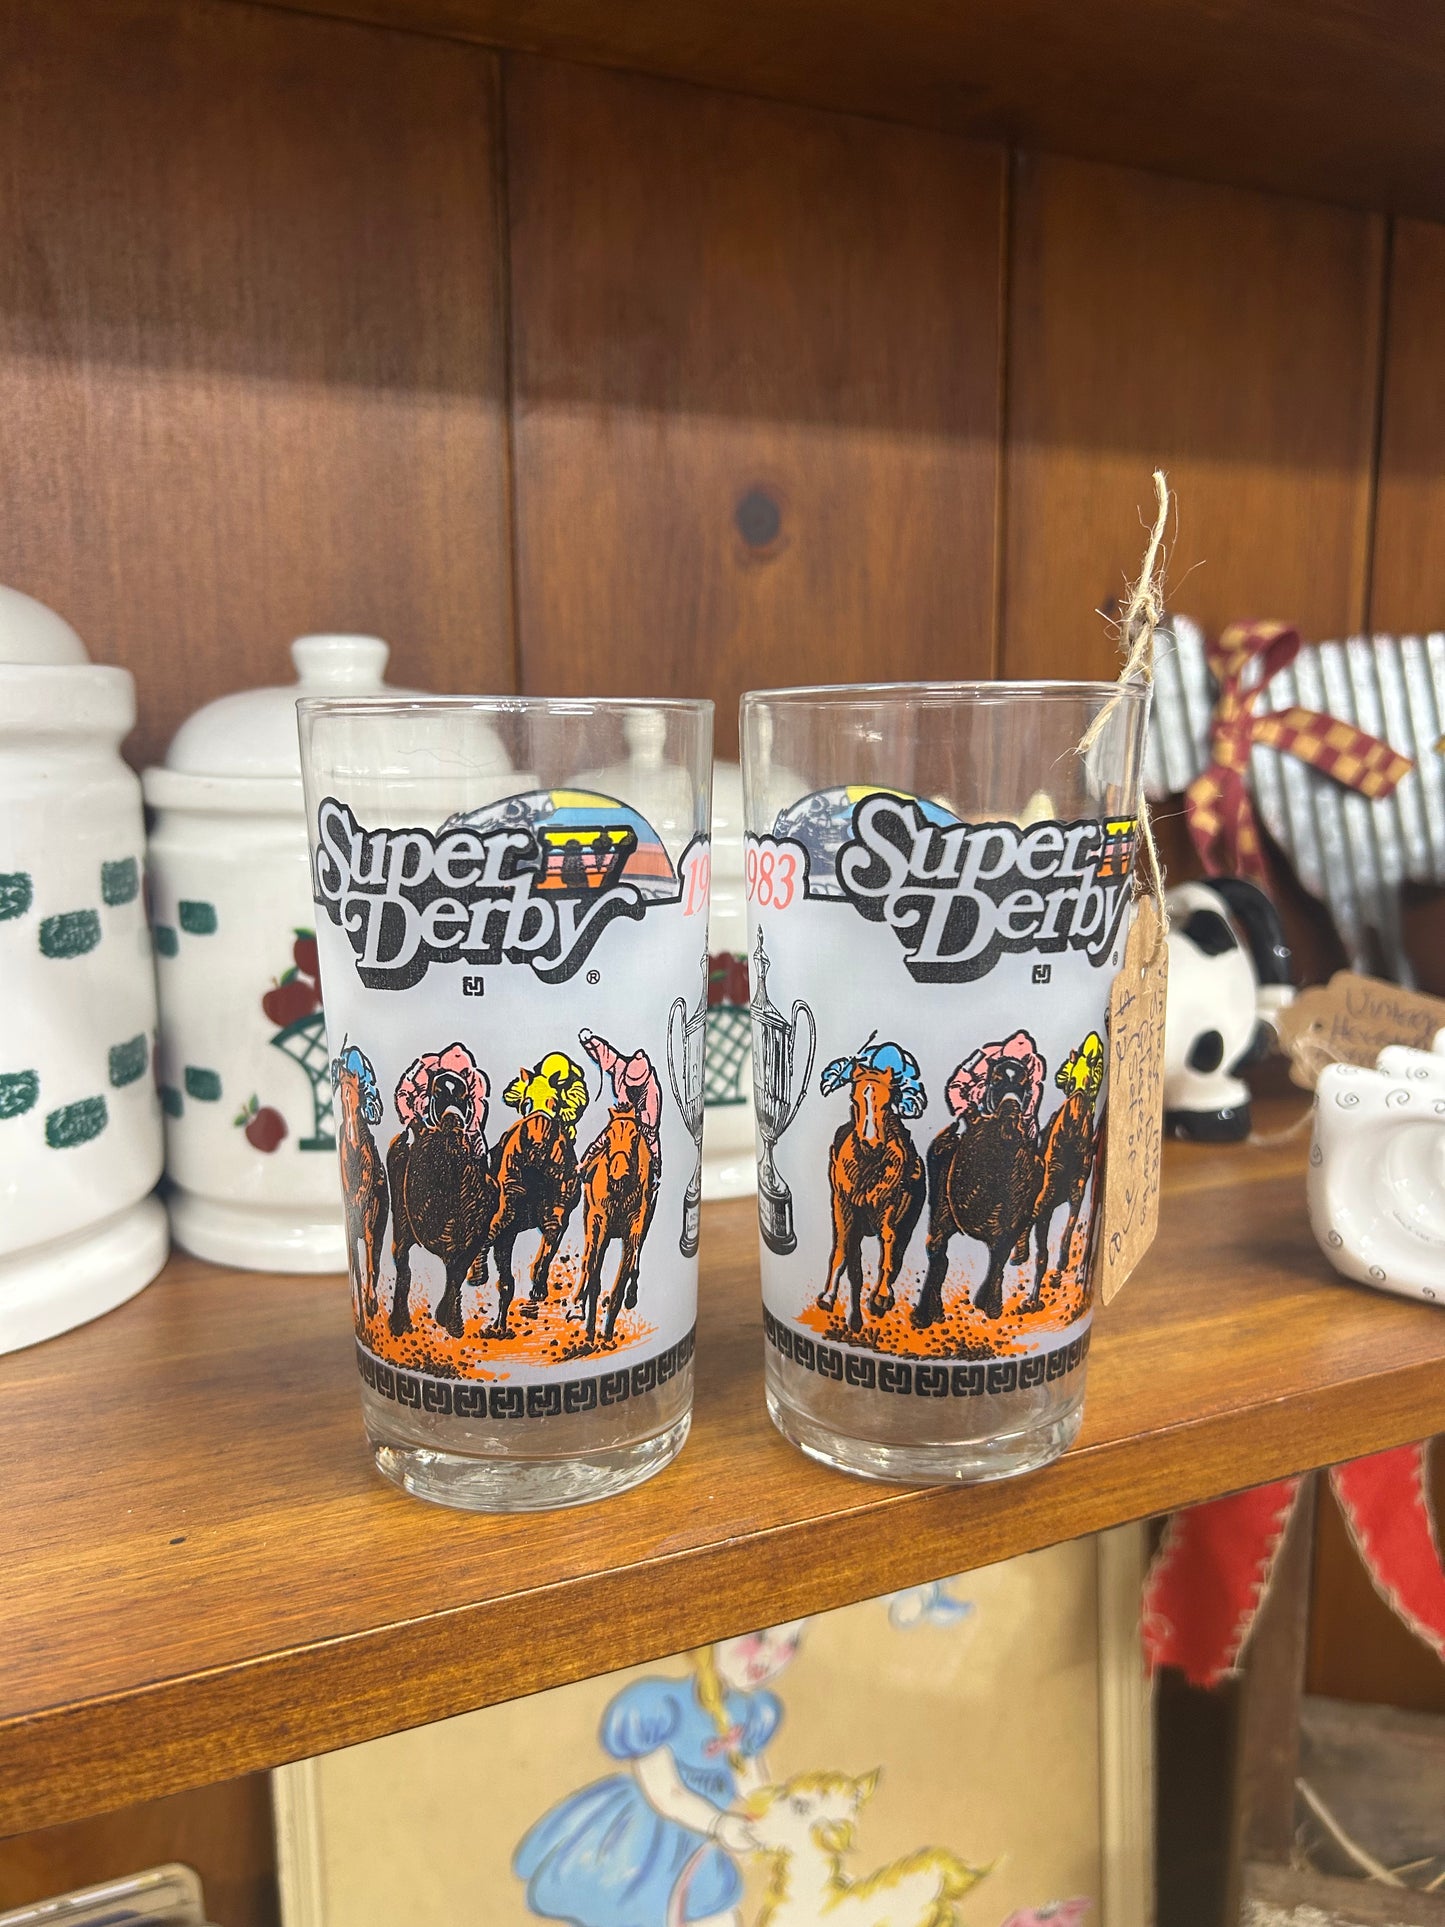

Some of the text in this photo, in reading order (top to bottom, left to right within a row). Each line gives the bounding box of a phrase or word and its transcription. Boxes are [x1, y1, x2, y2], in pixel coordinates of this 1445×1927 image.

[316, 799, 530, 901] Super
[745, 849, 796, 910] 983
[842, 798, 1095, 897] Super
[341, 867, 640, 970] Derby
[883, 864, 1133, 963] Derby
[1114, 988, 1136, 1085] $12
[1136, 1020, 1151, 1142] Glasses
[1147, 991, 1158, 1102] Super
